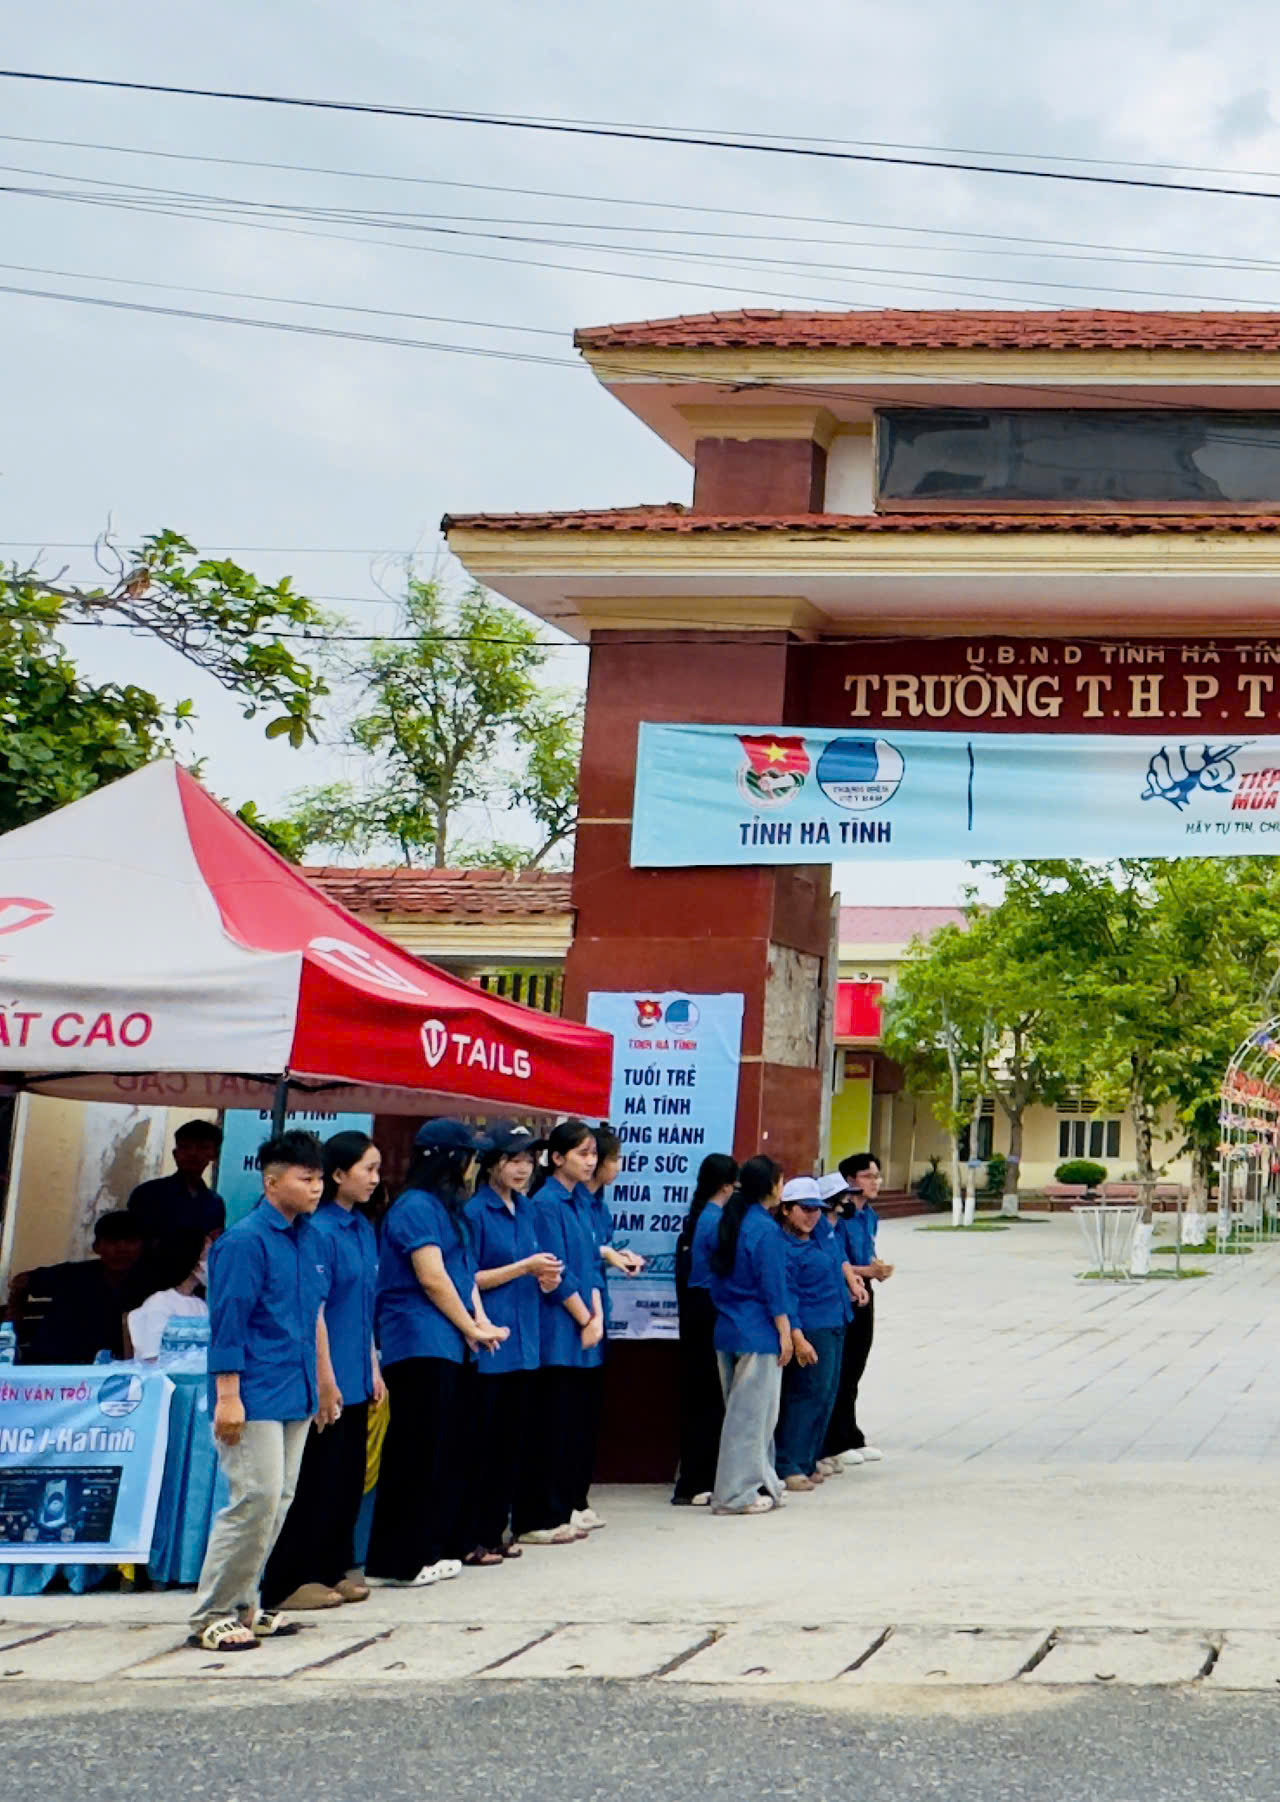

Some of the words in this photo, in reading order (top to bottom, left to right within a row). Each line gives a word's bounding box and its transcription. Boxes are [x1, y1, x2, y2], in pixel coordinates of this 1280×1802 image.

[966, 646, 1082, 664] U.B.N.D
[844, 664, 1064, 718] TRƯỜNG
[740, 814, 792, 846] TỈNH
[800, 816, 831, 846] HÀ
[839, 816, 892, 845] TĨNH
[51, 1011, 153, 1048] CAO
[451, 1033, 532, 1079] TAILG
[624, 1062, 661, 1086] TUỔI
[666, 1064, 697, 1087] TRẺ
[624, 1094, 647, 1115] HÀ
[653, 1095, 691, 1116] TĨNH
[658, 1123, 705, 1145] HÀNH
[619, 1149, 649, 1173] IẾP
[654, 1153, 689, 1174] SỨC
[613, 1182, 651, 1202] MÙA
[663, 1185, 689, 1203] THI
